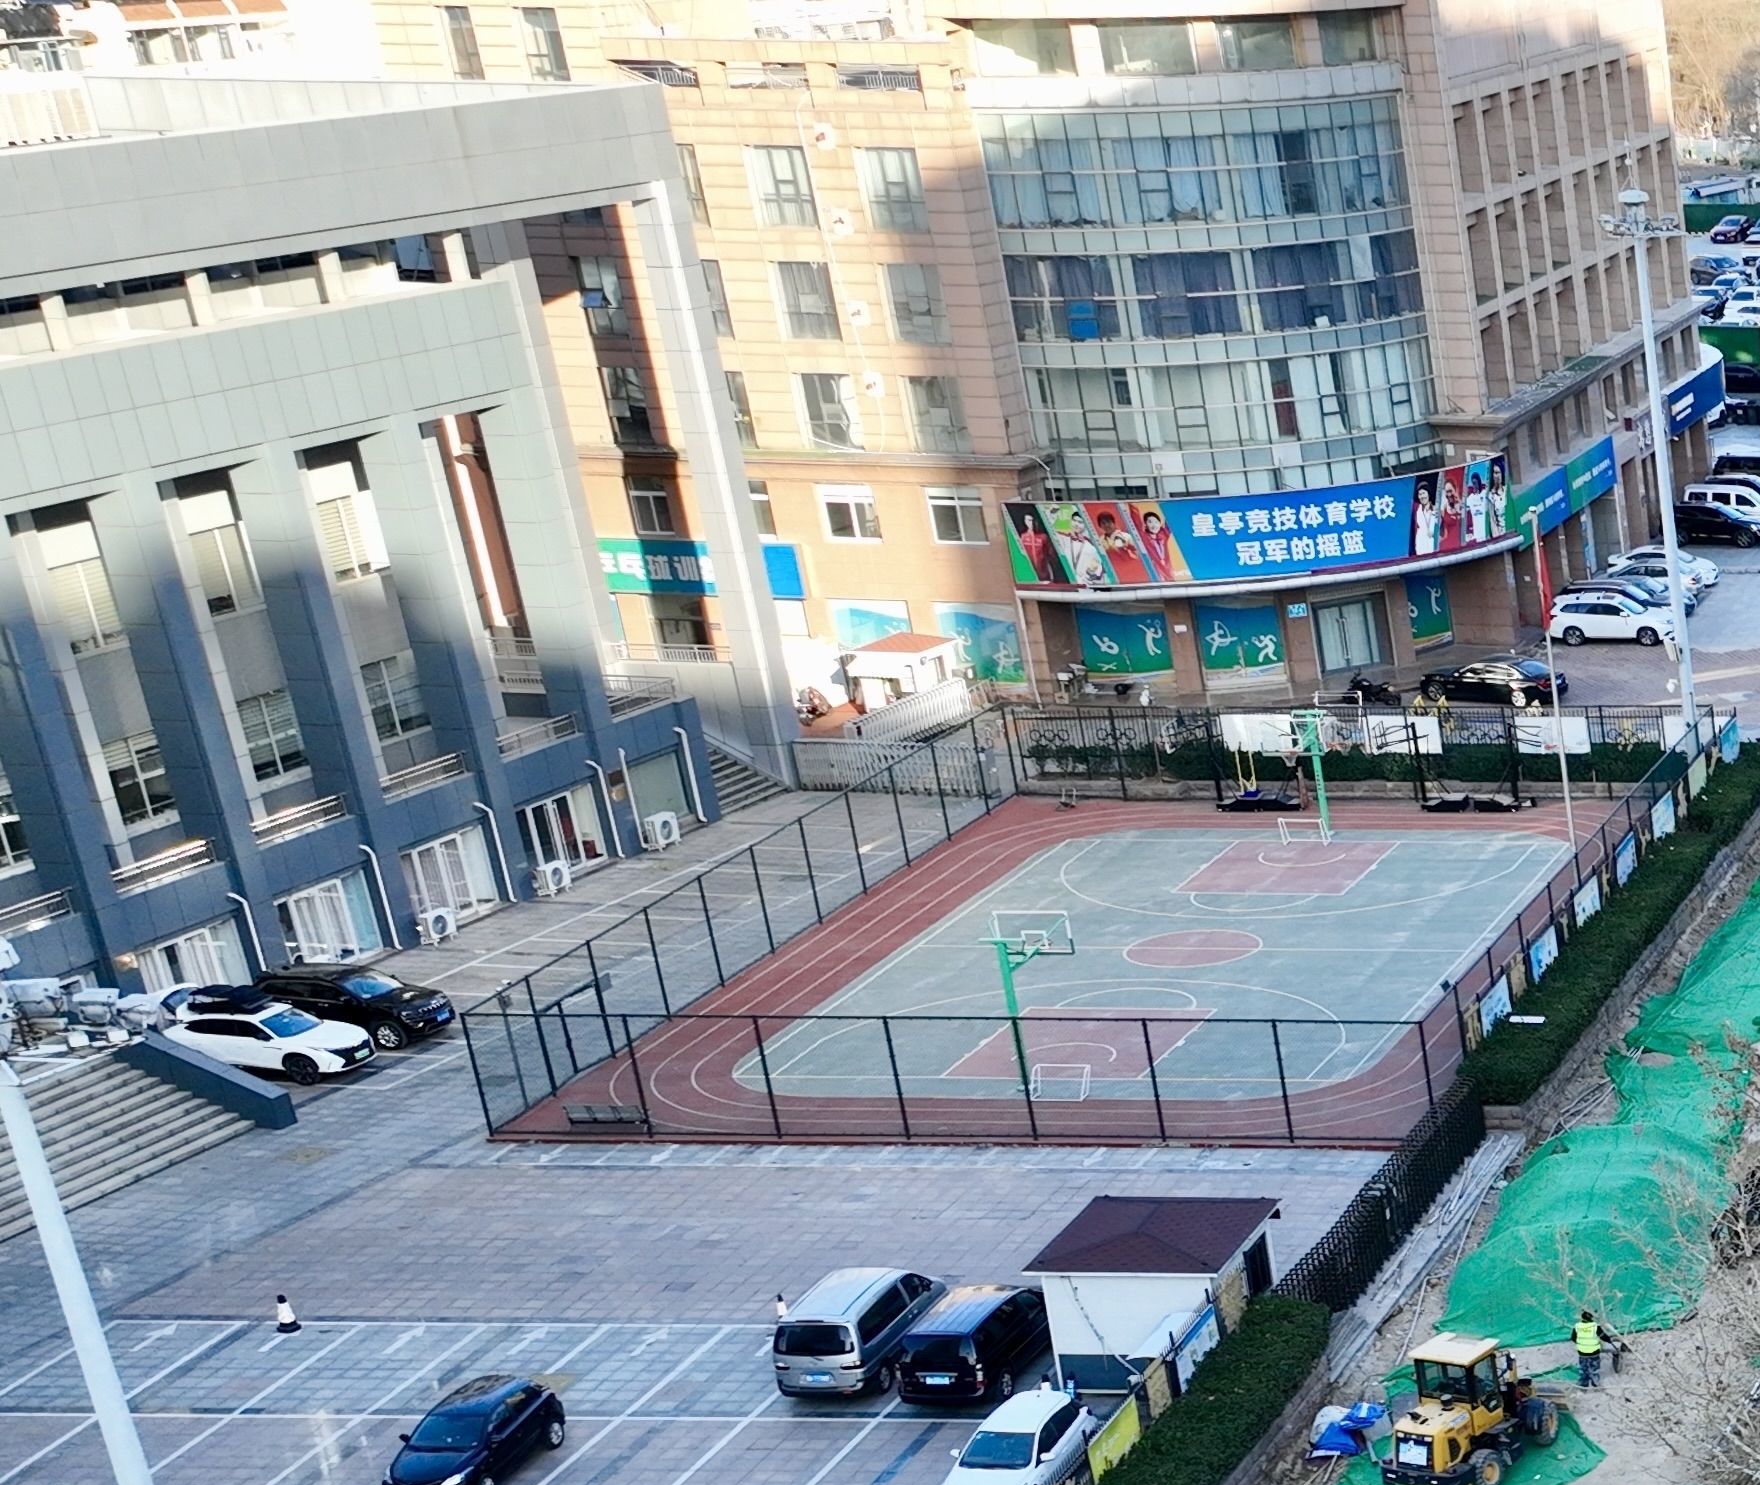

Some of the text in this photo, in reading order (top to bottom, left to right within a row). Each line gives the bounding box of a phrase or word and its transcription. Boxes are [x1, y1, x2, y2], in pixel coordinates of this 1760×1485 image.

[1191, 494, 1396, 537] 皇亭竞技体育学校
[1236, 530, 1366, 566] 冠军的摇篮
